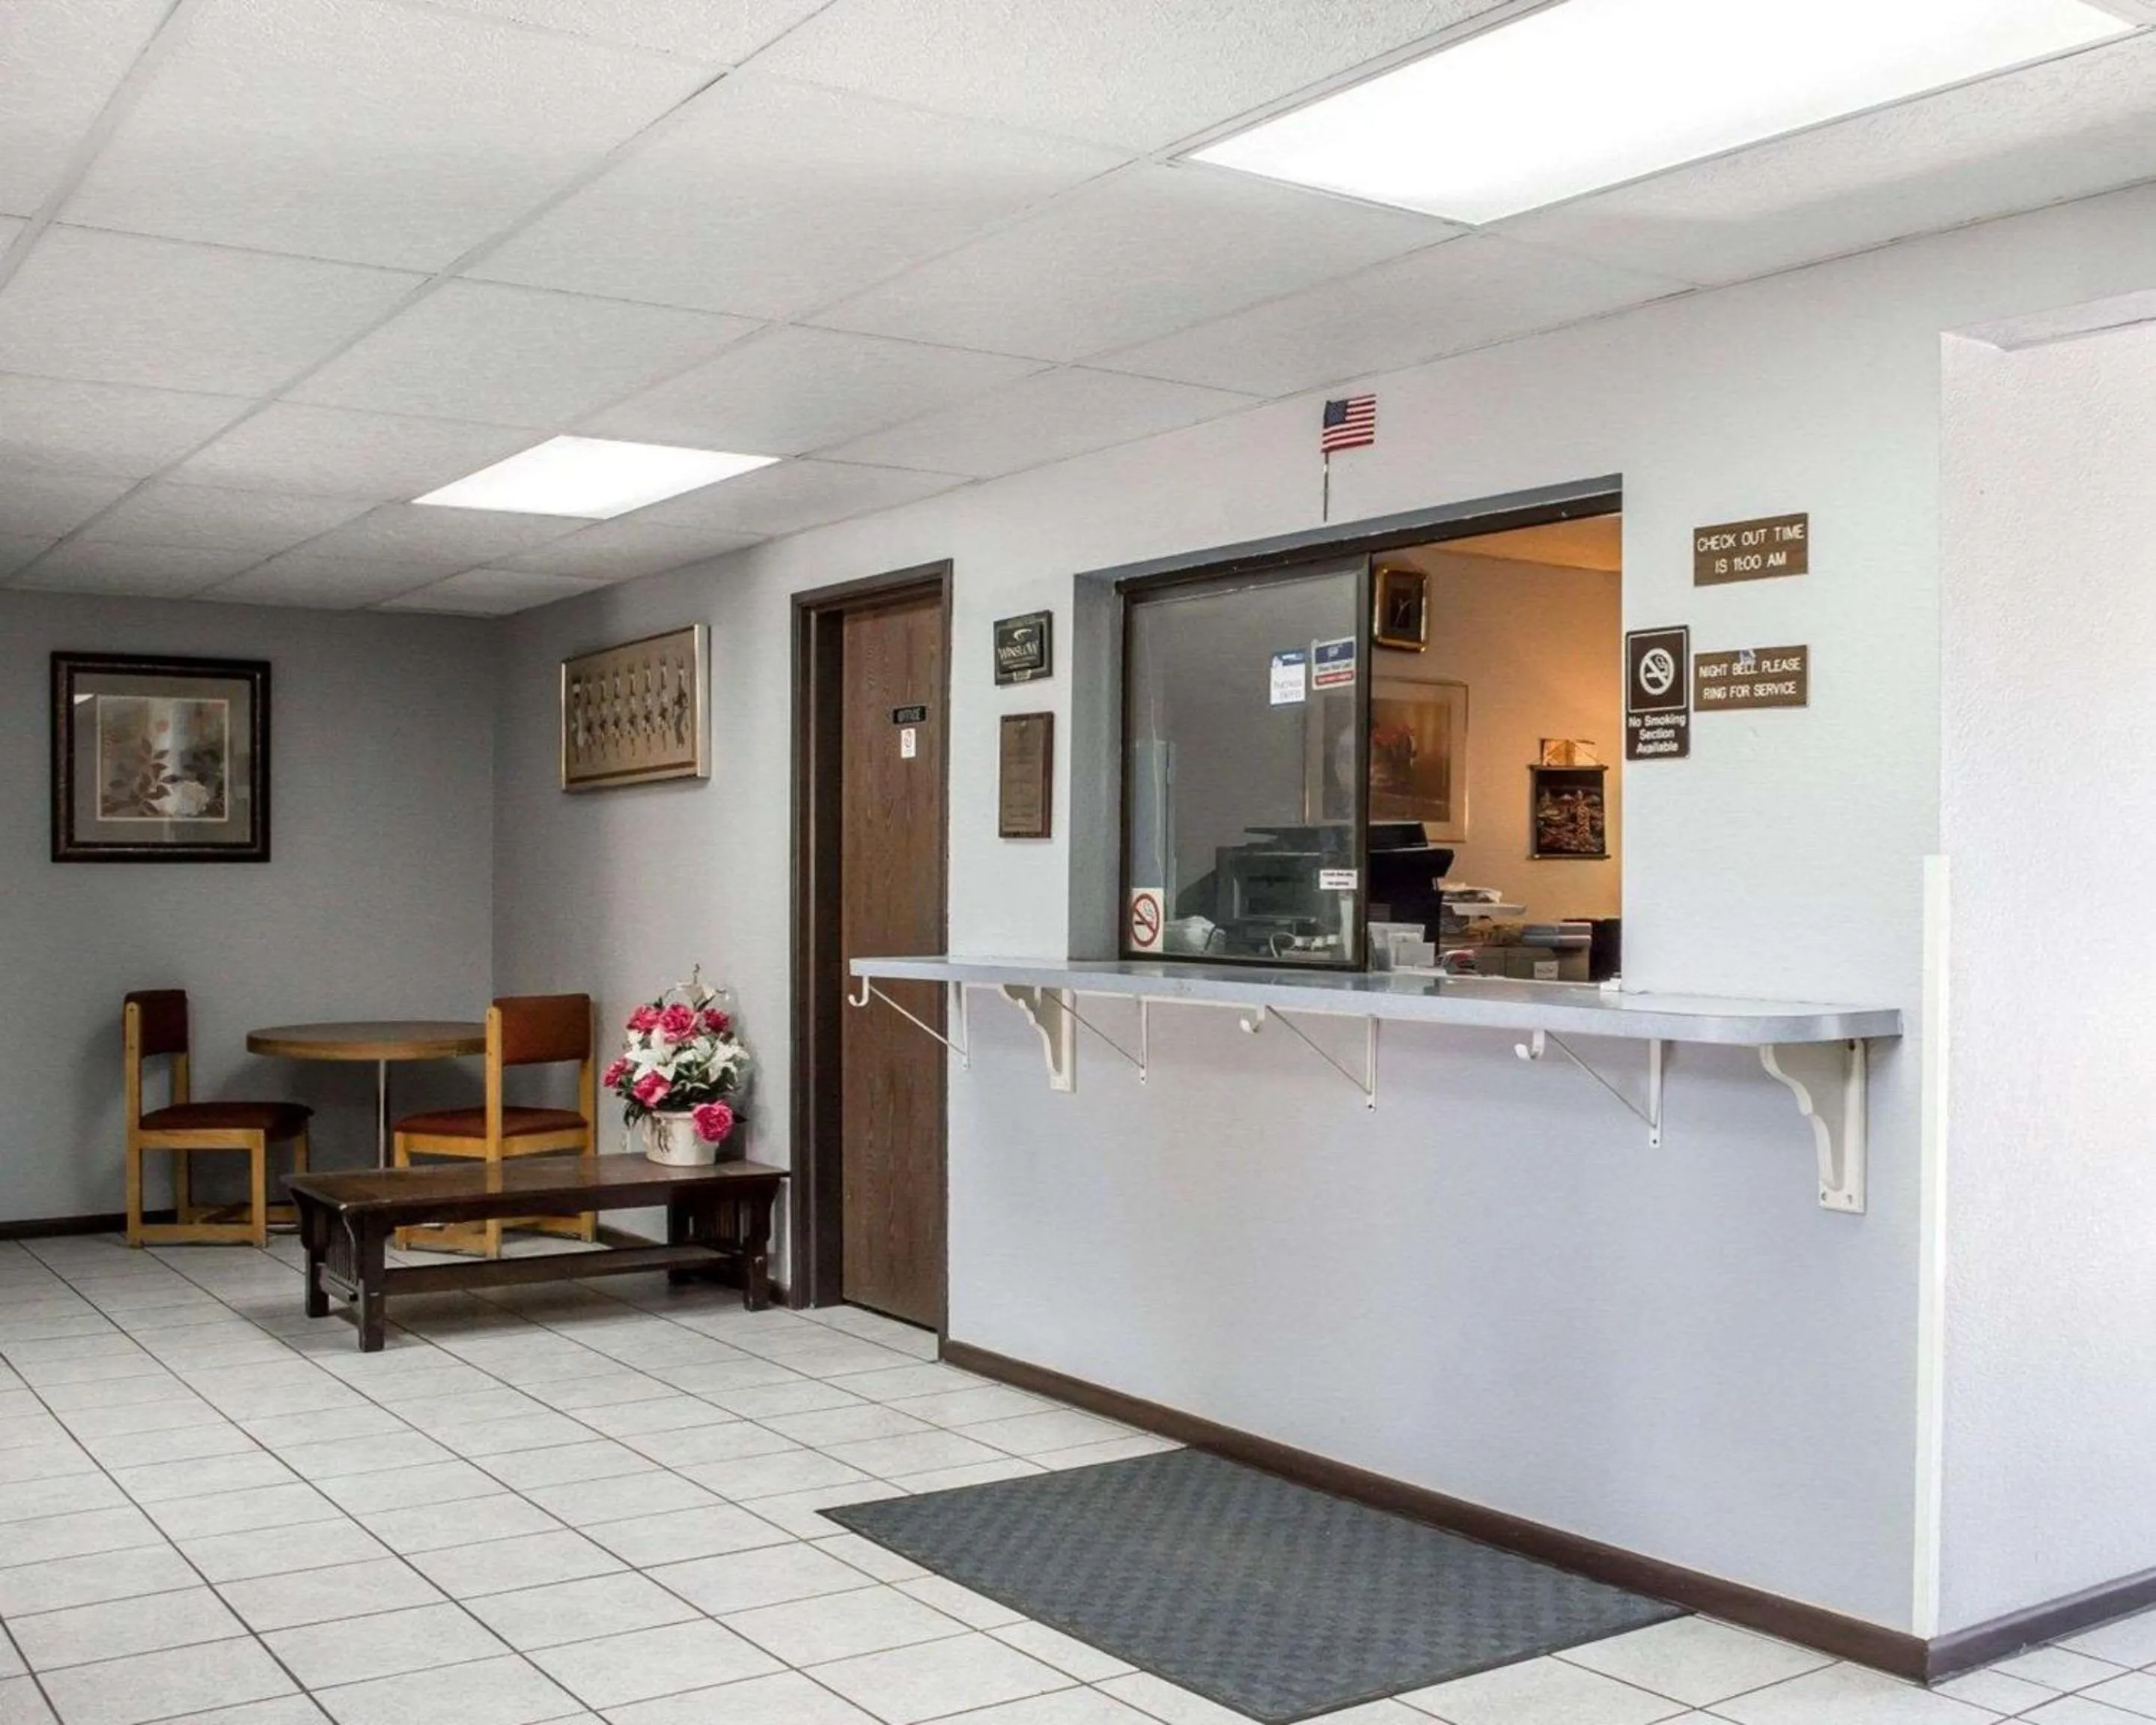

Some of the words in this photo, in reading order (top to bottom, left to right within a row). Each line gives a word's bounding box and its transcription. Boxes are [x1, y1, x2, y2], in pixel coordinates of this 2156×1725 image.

[1697, 533, 1737, 553] CHECK
[1741, 529, 1767, 546] OUT
[1773, 523, 1805, 542] TIME
[1714, 559, 1728, 574] IS
[1734, 554, 1761, 571] 11:00
[1767, 551, 1787, 568] AM
[1699, 663, 1728, 678] NIGHT
[1732, 661, 1758, 676] BELL
[1761, 657, 1802, 674] PLEASE
[1703, 686, 1727, 701] RING
[1729, 684, 1750, 699] FOR
[1753, 681, 1797, 698] SERVICE
[1628, 716, 1642, 728] No
[1645, 714, 1686, 727] Smoking
[1639, 728, 1675, 741] Section
[1636, 740, 1679, 755] Available
